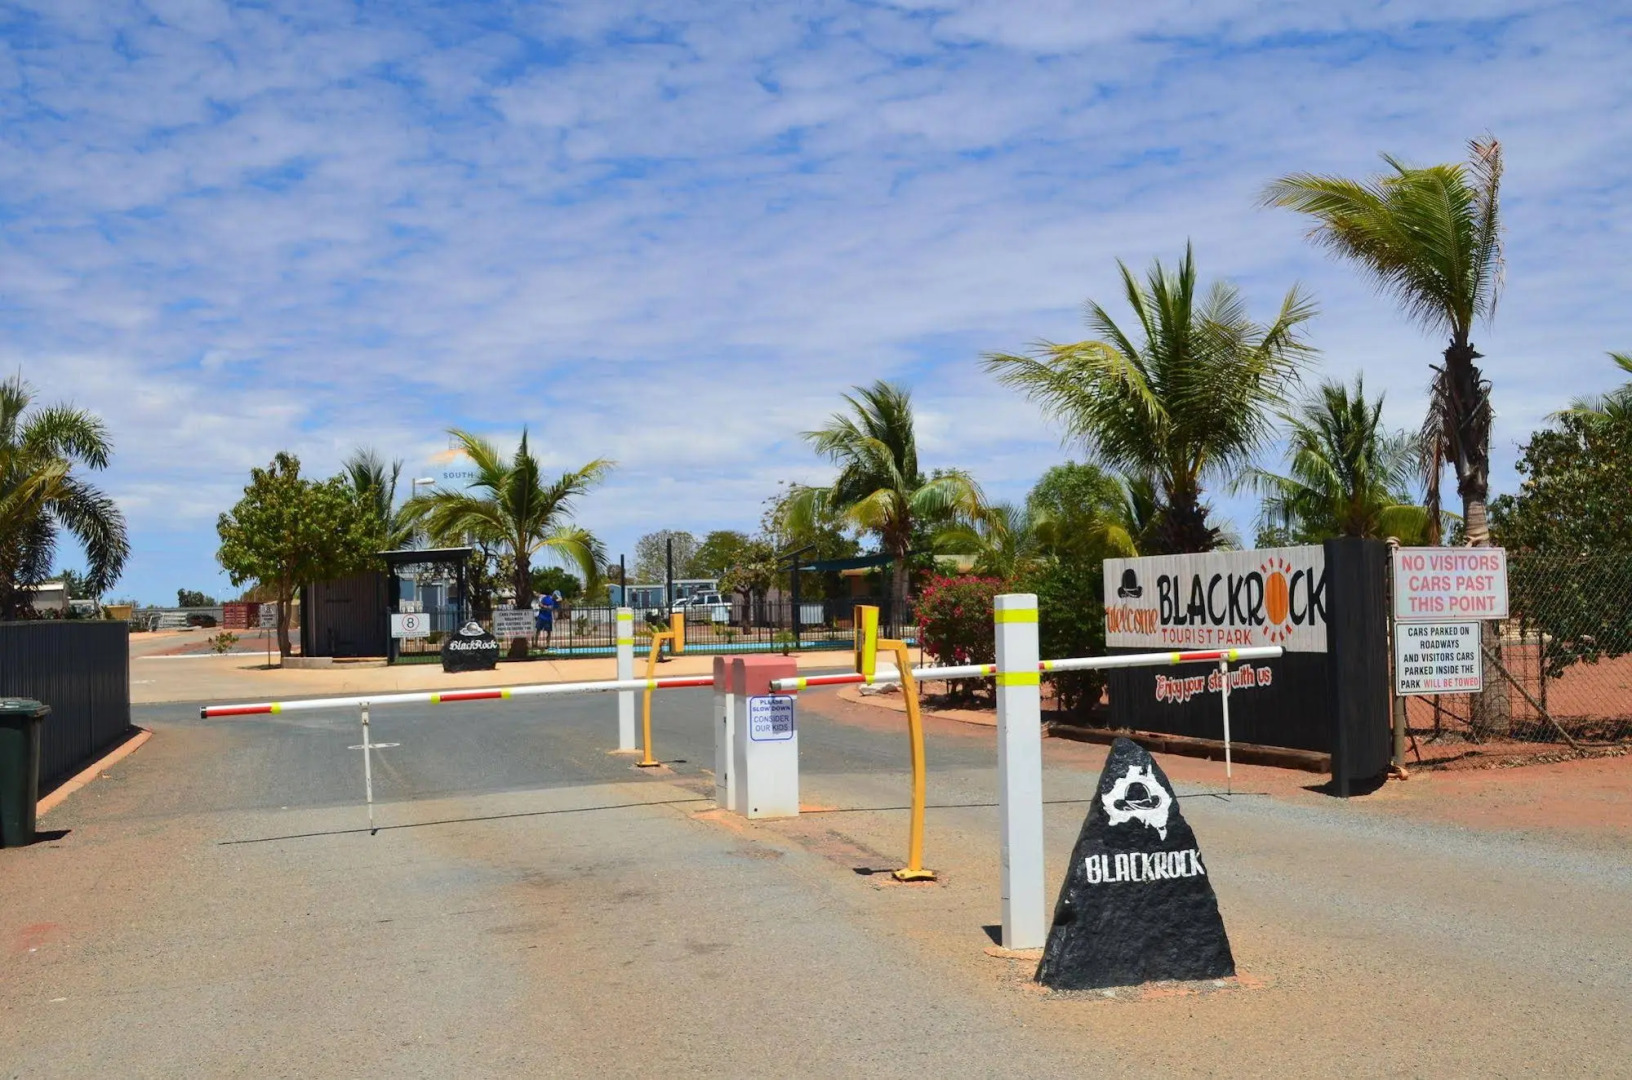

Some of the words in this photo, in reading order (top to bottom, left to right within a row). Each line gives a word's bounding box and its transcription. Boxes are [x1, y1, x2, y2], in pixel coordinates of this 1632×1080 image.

[1401, 555, 1425, 571] NO
[1429, 555, 1499, 571] VISITORS
[1409, 575, 1451, 591] CARS
[1456, 575, 1494, 591] PAST
[1157, 566, 1327, 627] BLACKROCK
[1408, 596, 1444, 612] THIS
[1449, 595, 1496, 611] POINT
[406, 617, 415, 628] 8
[1161, 628, 1212, 645] TOURIST
[1217, 628, 1252, 645] PARK
[1408, 627, 1428, 637] CARS
[1430, 626, 1458, 636] PARKED
[1459, 626, 1470, 635] ON
[449, 639, 498, 650] BlackRock
[1420, 639, 1460, 649] ROADWAYS
[1403, 653, 1419, 662] AND
[1421, 652, 1454, 662] VISITORS
[1456, 651, 1475, 661] CARS
[1404, 665, 1434, 676] PARKED
[1435, 665, 1459, 675] INSIDE
[1461, 664, 1474, 674] THE
[1155, 673, 1183, 704] Enjoy
[1182, 675, 1205, 702] your
[1231, 663, 1255, 689] with
[1257, 666, 1272, 687] us
[1400, 679, 1421, 689] PARK
[1423, 678, 1441, 688] WILL
[1443, 677, 1453, 687] BE
[1455, 676, 1479, 687] TOWED
[754, 715, 789, 723] CONSIDER
[772, 723, 788, 731] KIDS
[1085, 849, 1205, 884] BLACKROCK
